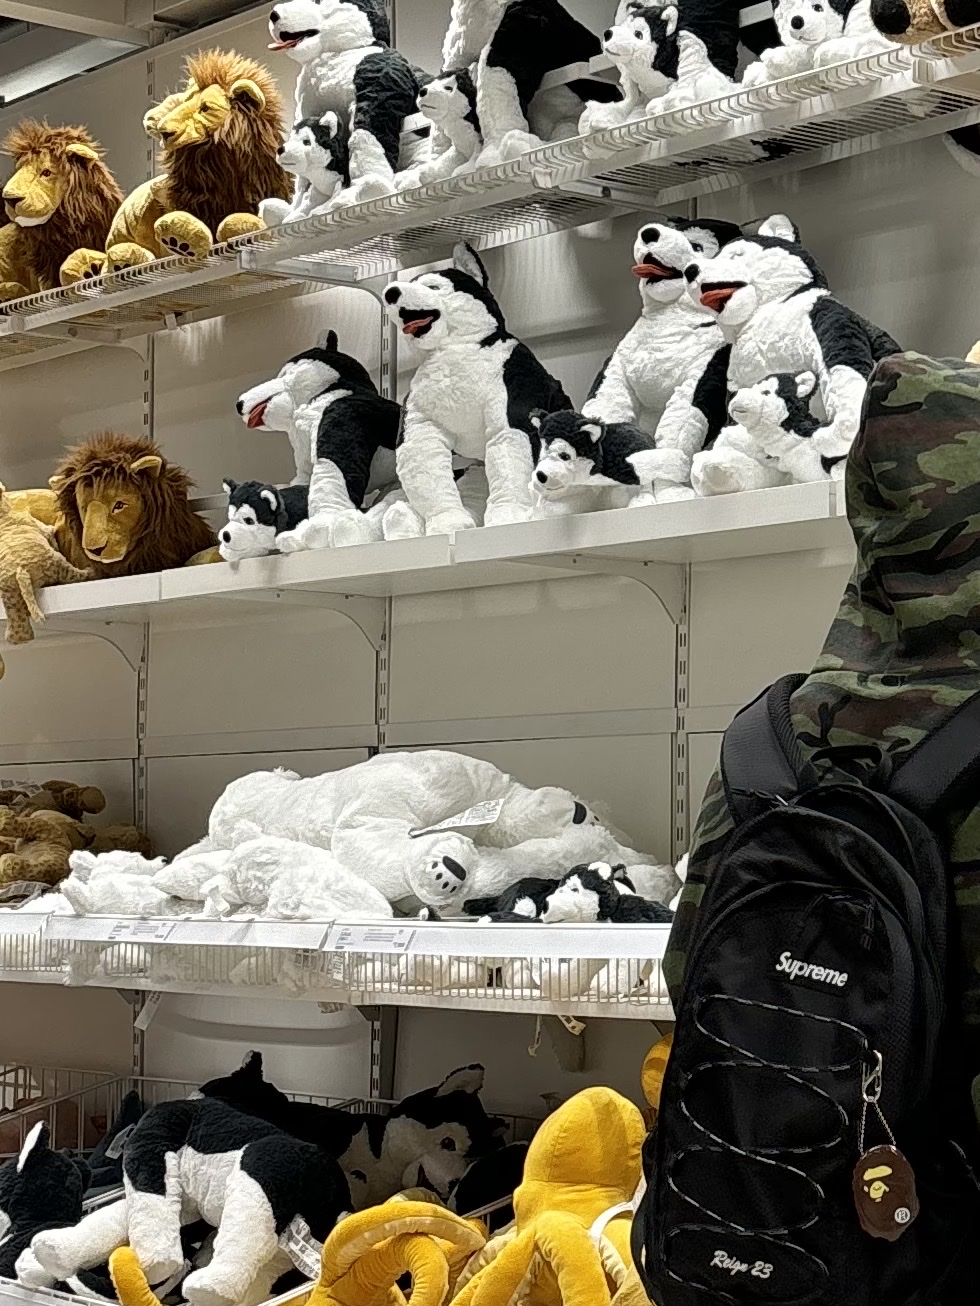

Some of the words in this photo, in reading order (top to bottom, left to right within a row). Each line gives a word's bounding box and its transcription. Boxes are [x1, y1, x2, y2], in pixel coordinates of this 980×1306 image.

[776, 951, 848, 987] Supreme
[710, 1250, 749, 1276] Reign
[751, 1261, 774, 1279] 23
